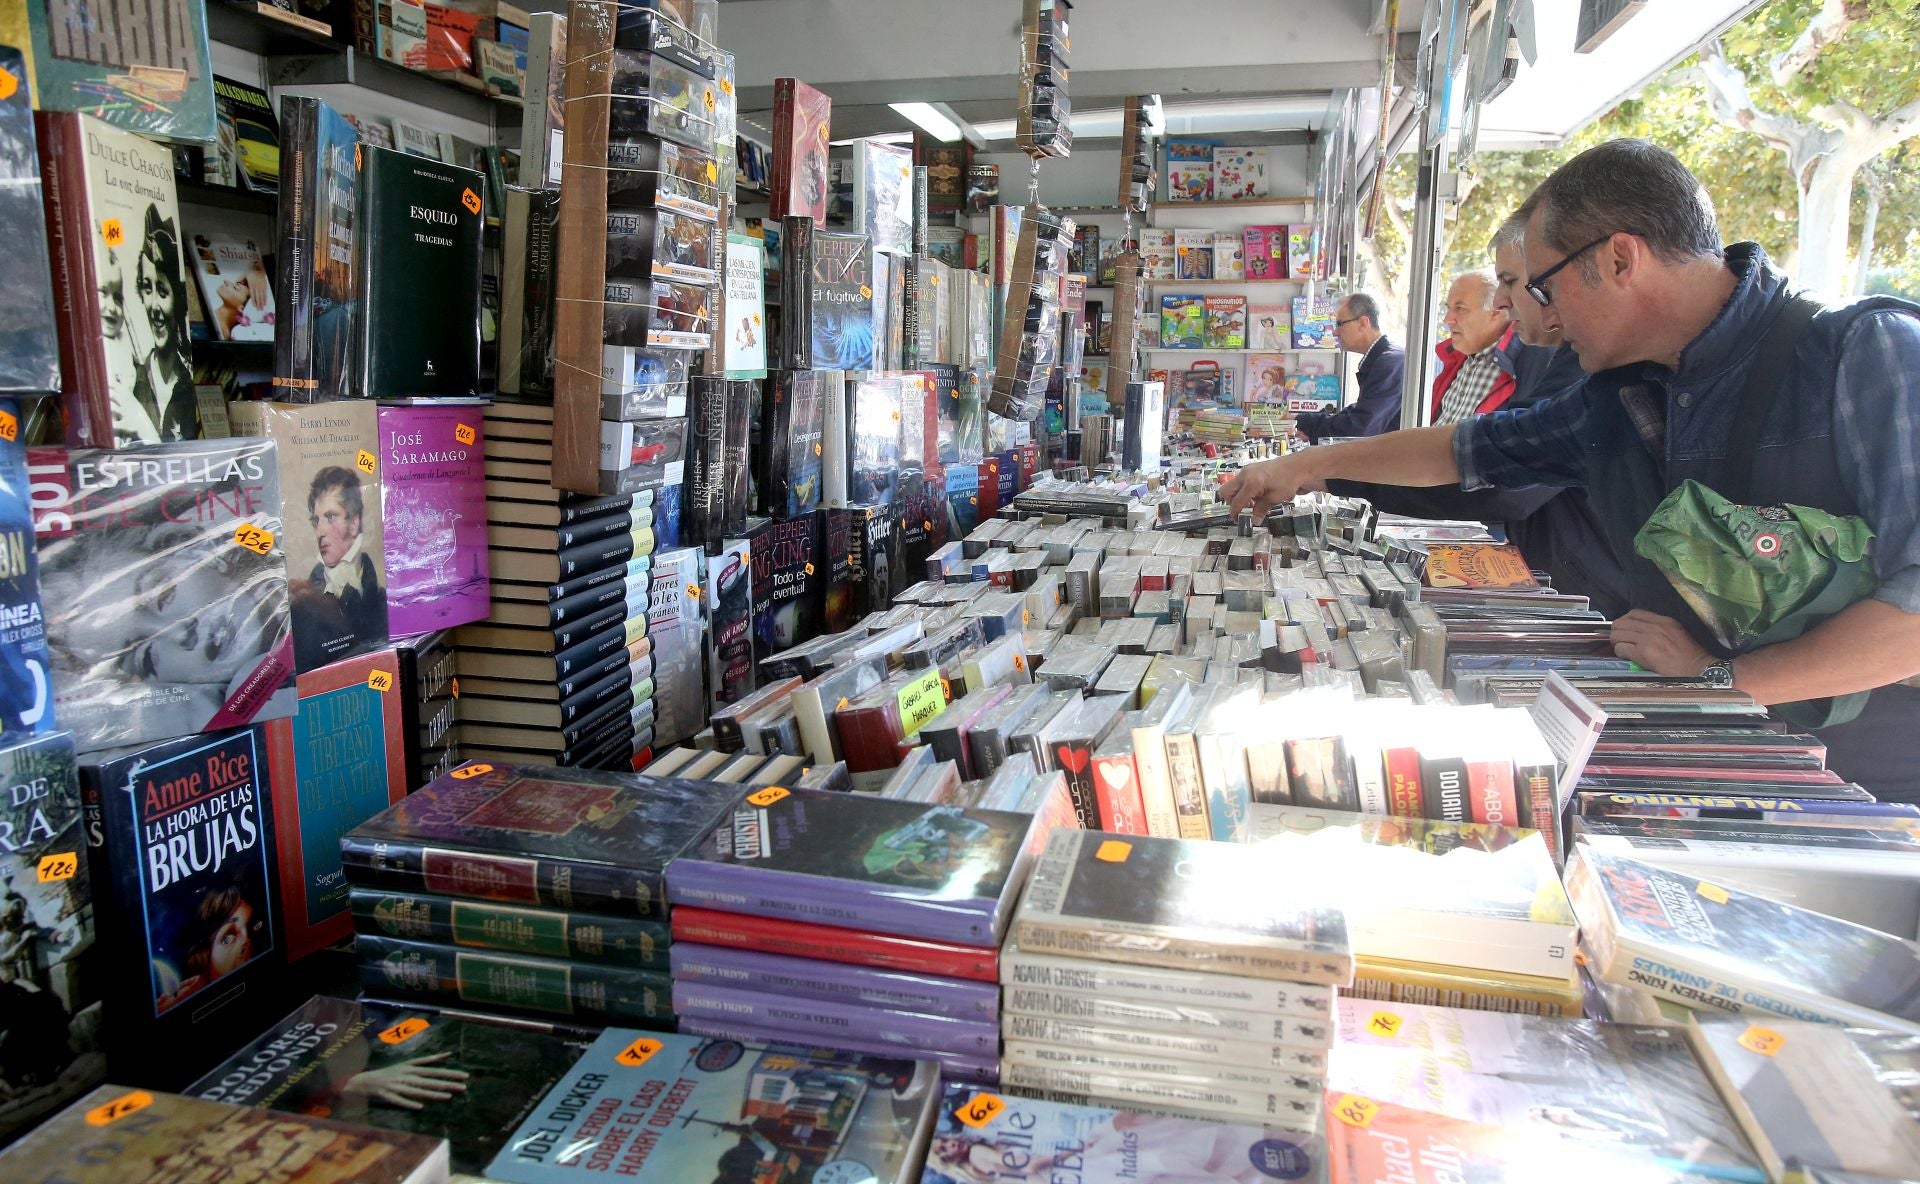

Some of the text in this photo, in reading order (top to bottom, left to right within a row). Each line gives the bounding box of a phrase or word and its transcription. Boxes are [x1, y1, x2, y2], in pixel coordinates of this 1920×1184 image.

[215, 81, 270, 110] VOLKSWAGEN
[400, 124, 423, 145] MIGUEL
[88, 132, 172, 182] DULCE CHACÓN
[414, 170, 437, 180] BIBLIOTECA
[968, 168, 998, 177] cocina
[105, 169, 118, 188] La
[134, 176, 166, 202] dormida
[410, 205, 458, 226] ESQUILO
[106, 225, 120, 240] 10€
[414, 233, 453, 248] TRAGEDIAS
[290, 246, 302, 306] Michael Connelly
[812, 258, 867, 284] KING
[712, 288, 720, 306] ROLL
[812, 289, 863, 304] El fugitivo
[300, 418, 352, 429] BARRY LYNDON
[709, 393, 722, 441] Negra
[390, 430, 422, 450] JOSÉ
[456, 428, 471, 438] 12€
[358, 454, 374, 470] 20€
[392, 450, 467, 465] SARAMAGO
[77, 456, 264, 490] ESTRELLAS
[428, 471, 436, 480] de
[694, 460, 702, 510] STEPHEN
[82, 486, 264, 529] DE CINE
[238, 530, 272, 551] 13€
[868, 516, 892, 550] Hitler
[772, 536, 812, 569] KING
[652, 578, 679, 594] dores
[773, 570, 806, 587] Todo es
[773, 581, 806, 600] eventual
[0, 602, 42, 630] ÍNEA
[0, 624, 44, 644] ALEX CROSS
[721, 620, 748, 643] UN AMOR
[172, 686, 184, 694] DE
[235, 666, 272, 704] LOS CREADORES
[902, 678, 940, 710] GABRIEL GARCIA
[155, 693, 190, 706] DE CINE
[306, 688, 370, 738] EL LIBRO
[912, 700, 937, 725] MARQUEZ
[308, 724, 374, 775] TIBETANO
[10, 776, 48, 808] DE
[144, 750, 250, 816] Anne Rice
[1071, 781, 1082, 807] un
[1610, 794, 1804, 811] VALENTINO
[146, 784, 252, 845] LA HORA DE LAS
[734, 809, 760, 860] CHRISTIE
[148, 804, 257, 893] BRUJAS
[42, 861, 73, 878] 12€
[680, 886, 746, 904] AGATHA CHRISTIE
[1602, 864, 1672, 930] KING
[1650, 874, 1701, 943] CEMENTERIO
[682, 962, 749, 980] AGATHA CHRISTIE
[1013, 964, 1098, 990] AGATHA CHRISTIE
[1632, 956, 1738, 999] ANIMALES DE
[1012, 990, 1096, 1016] AGATHA CHRISTIE
[1628, 970, 1742, 1014] STEPHEN KING
[688, 998, 754, 1014] AGATHA CHRISTIE
[814, 1014, 849, 1026] TERCERA
[1010, 1018, 1048, 1037] AGATHA
[1373, 1016, 1396, 1031] 7€
[322, 1016, 376, 1058] invisible
[393, 1026, 415, 1040] 7€
[628, 1044, 652, 1058] 7€
[1172, 1040, 1219, 1054] POLLENSA
[202, 1022, 315, 1101] DOLORES
[219, 1022, 338, 1105] REDONDO
[1140, 1062, 1178, 1075] MUERTO
[102, 1100, 137, 1119] 7€
[970, 1100, 997, 1122] 6€
[1267, 1094, 1276, 1114] 299
[1342, 1102, 1369, 1123] 8€
[518, 1072, 610, 1164] JOËL DICKER
[586, 1079, 668, 1173] SOBRE EL CASO
[616, 1077, 700, 1176] HARRY QUEBERT
[1116, 1130, 1138, 1179] hadas
[1263, 1146, 1280, 1171] BEST
